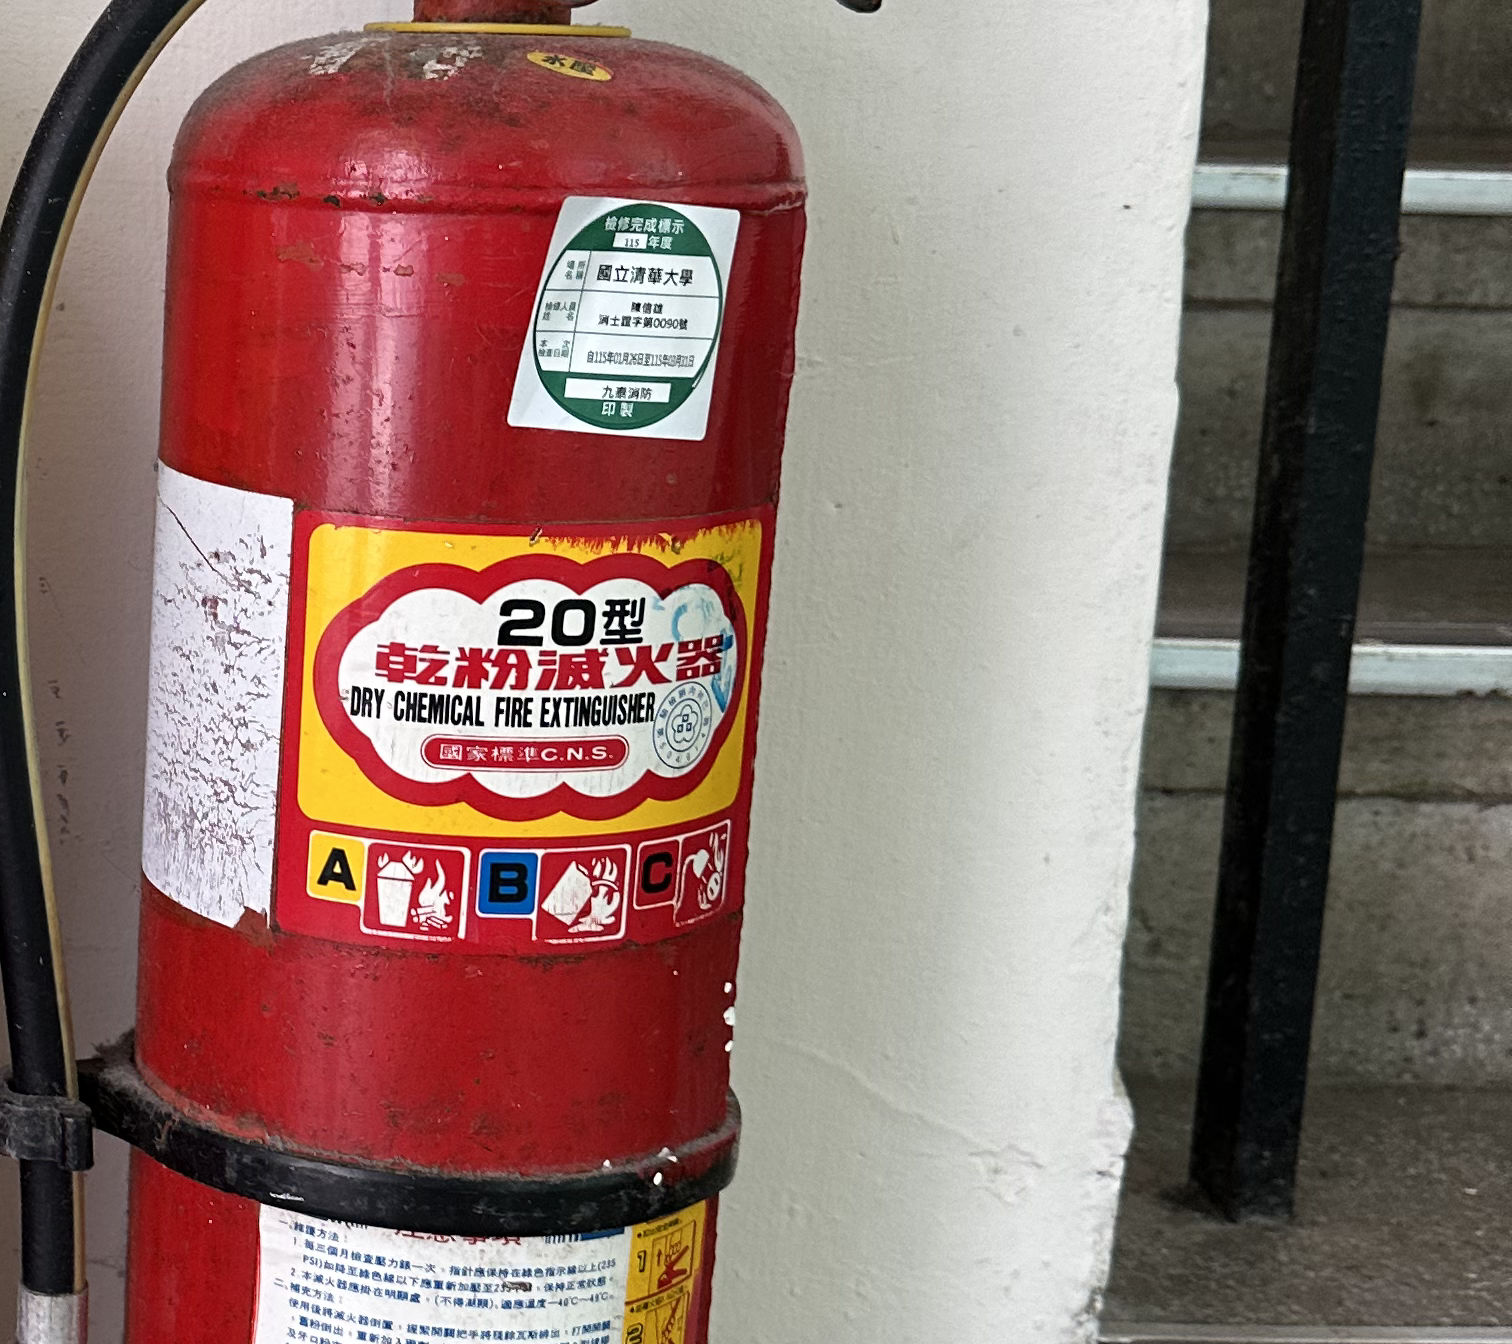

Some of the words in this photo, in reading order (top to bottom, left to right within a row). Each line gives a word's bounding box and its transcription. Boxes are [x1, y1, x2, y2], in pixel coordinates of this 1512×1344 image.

[604, 216, 685, 234] 檢修完成標示
[624, 237, 640, 248] 115
[648, 235, 673, 250] 年度
[596, 264, 694, 287] 國立清華大學
[496, 598, 647, 648] 20型
[374, 634, 724, 691] 乾粉滅火器
[350, 687, 384, 718] DRY
[393, 690, 486, 728] CHEMICAL
[494, 695, 532, 729] FIRE
[539, 691, 656, 729] EXTINGUISHER
[317, 849, 357, 893] A
[488, 863, 529, 903] B
[639, 853, 674, 893] C
